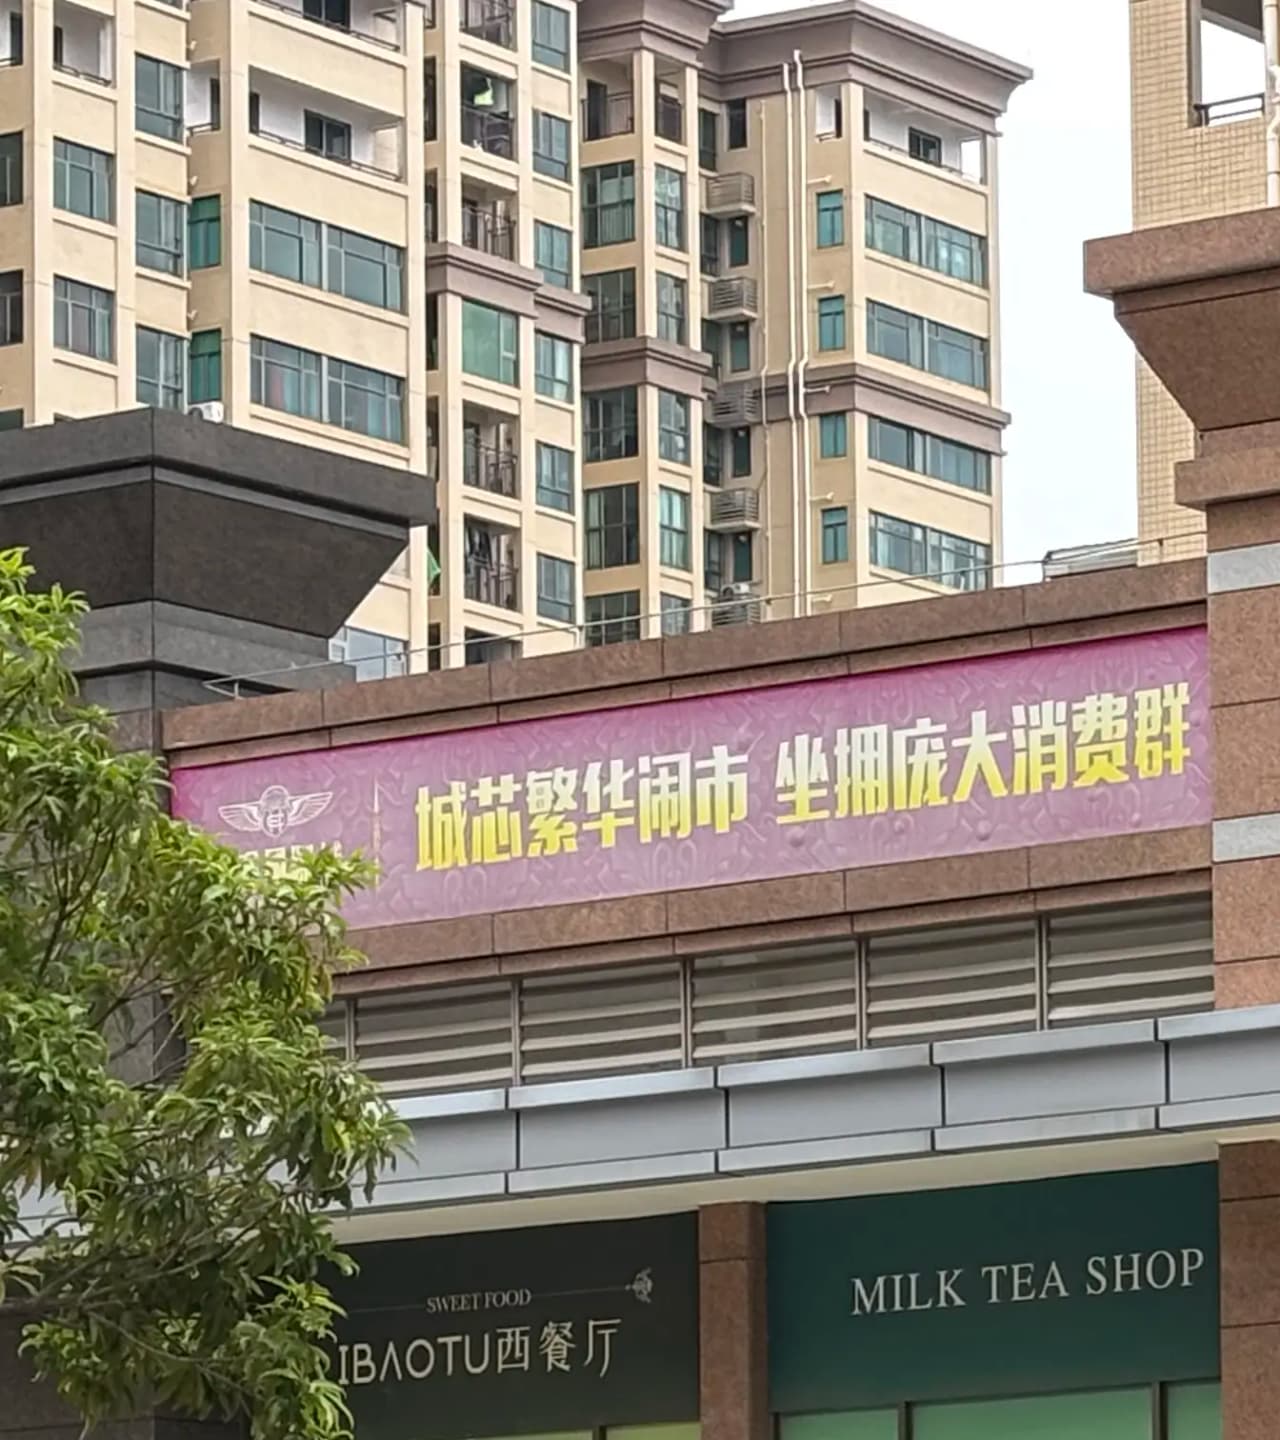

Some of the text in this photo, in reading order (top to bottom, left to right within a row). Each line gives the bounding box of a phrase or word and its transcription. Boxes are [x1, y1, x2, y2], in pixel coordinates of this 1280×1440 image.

[415, 683, 1191, 871] 城芯繁华闹市 坐拥庞大消费群
[426, 1289, 532, 1313] SWEET FOOD
[851, 1248, 1205, 1316] MILK TEA SHOP
